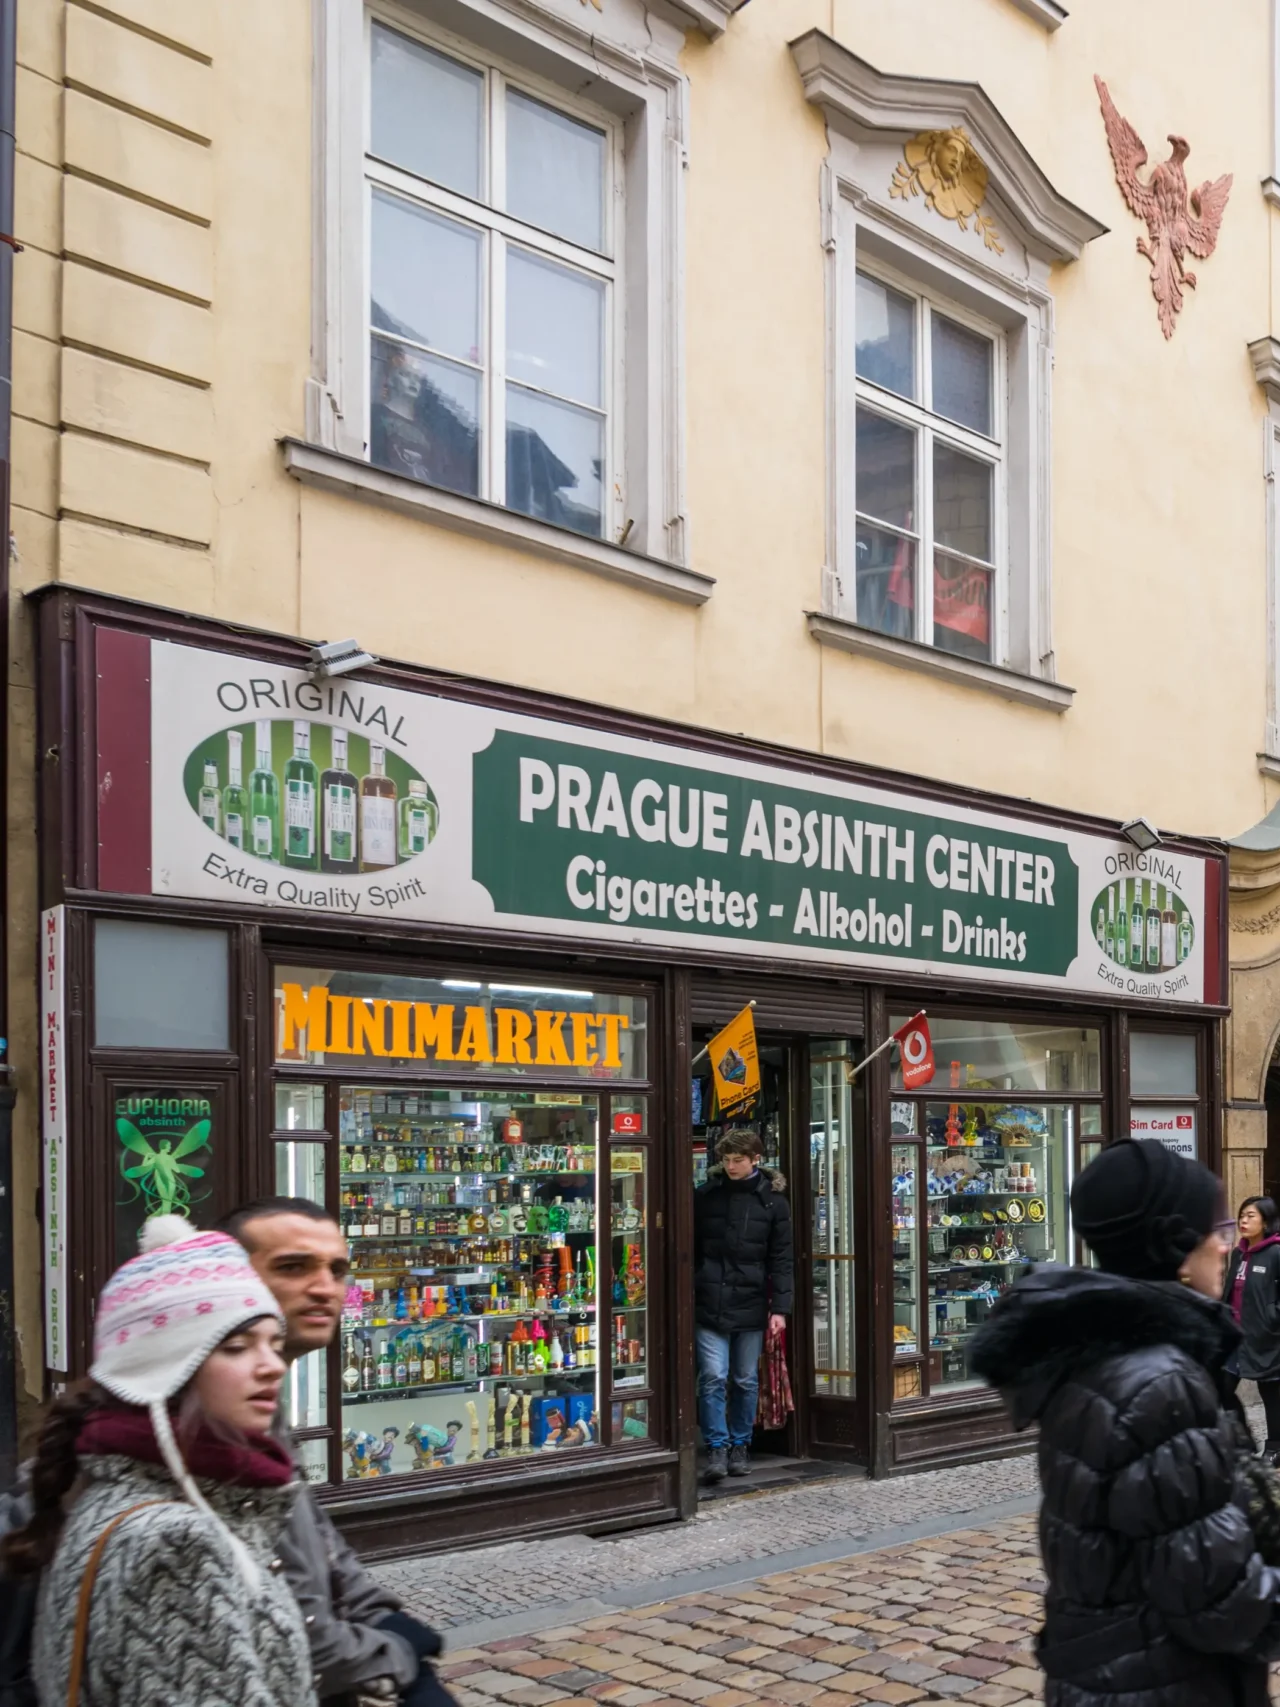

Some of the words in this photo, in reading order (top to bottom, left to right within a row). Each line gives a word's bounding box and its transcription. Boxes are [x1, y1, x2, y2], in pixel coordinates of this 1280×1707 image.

[217, 679, 408, 747] ORIGINAL
[519, 756, 729, 854] PRAGUE
[740, 799, 915, 883] ABSINTH
[925, 834, 1055, 906] CENTER
[202, 852, 269, 895] Extra
[277, 880, 360, 913] Quality
[368, 877, 427, 910] Spirit
[1104, 852, 1183, 890] ORIGINAL
[566, 855, 758, 929] Cigarettes
[793, 887, 912, 948] Alkohol
[942, 909, 1027, 962] Drinks
[47, 917, 57, 991] MINI
[1097, 962, 1124, 989] Extra
[1127, 978, 1162, 998] Quality
[1164, 974, 1189, 995] Spirit
[282, 982, 629, 1068] MINIMARKET
[47, 1012, 57, 1123] MARKET
[720, 1091, 742, 1107] Phone
[743, 1081, 760, 1096] Card
[906, 1062, 932, 1077] vodafone
[115, 1098, 211, 1116] EUPHORIA
[139, 1117, 186, 1126] absinth
[1130, 1120, 1148, 1130] Sim
[1151, 1119, 1173, 1130] Card
[50, 1139, 59, 1268] ABSINTH
[51, 1289, 59, 1361] SHOP
